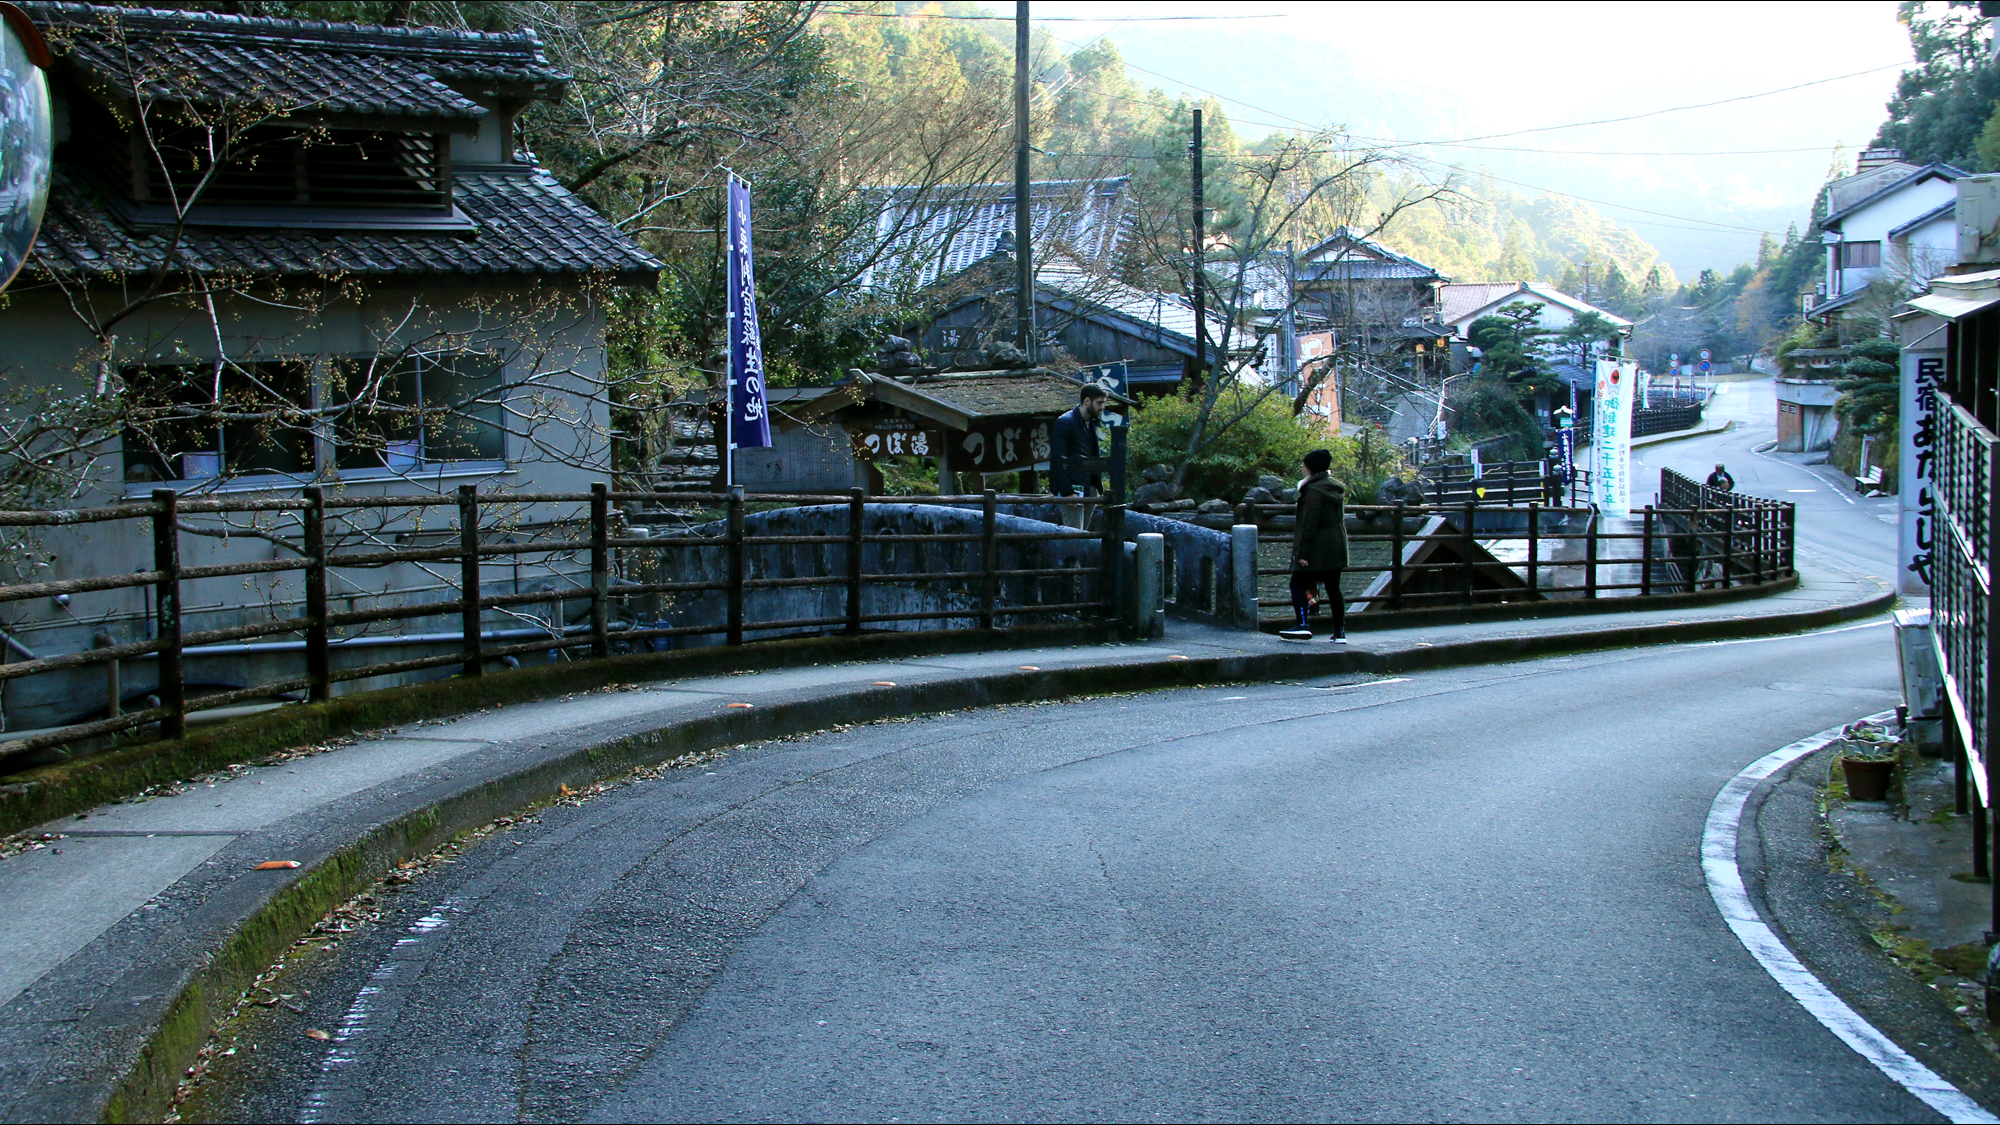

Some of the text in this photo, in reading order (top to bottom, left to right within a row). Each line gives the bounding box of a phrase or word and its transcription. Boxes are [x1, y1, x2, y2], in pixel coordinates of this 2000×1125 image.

[864, 431, 929, 455] つぼ湯
[963, 422, 1050, 465] つぼ湯
